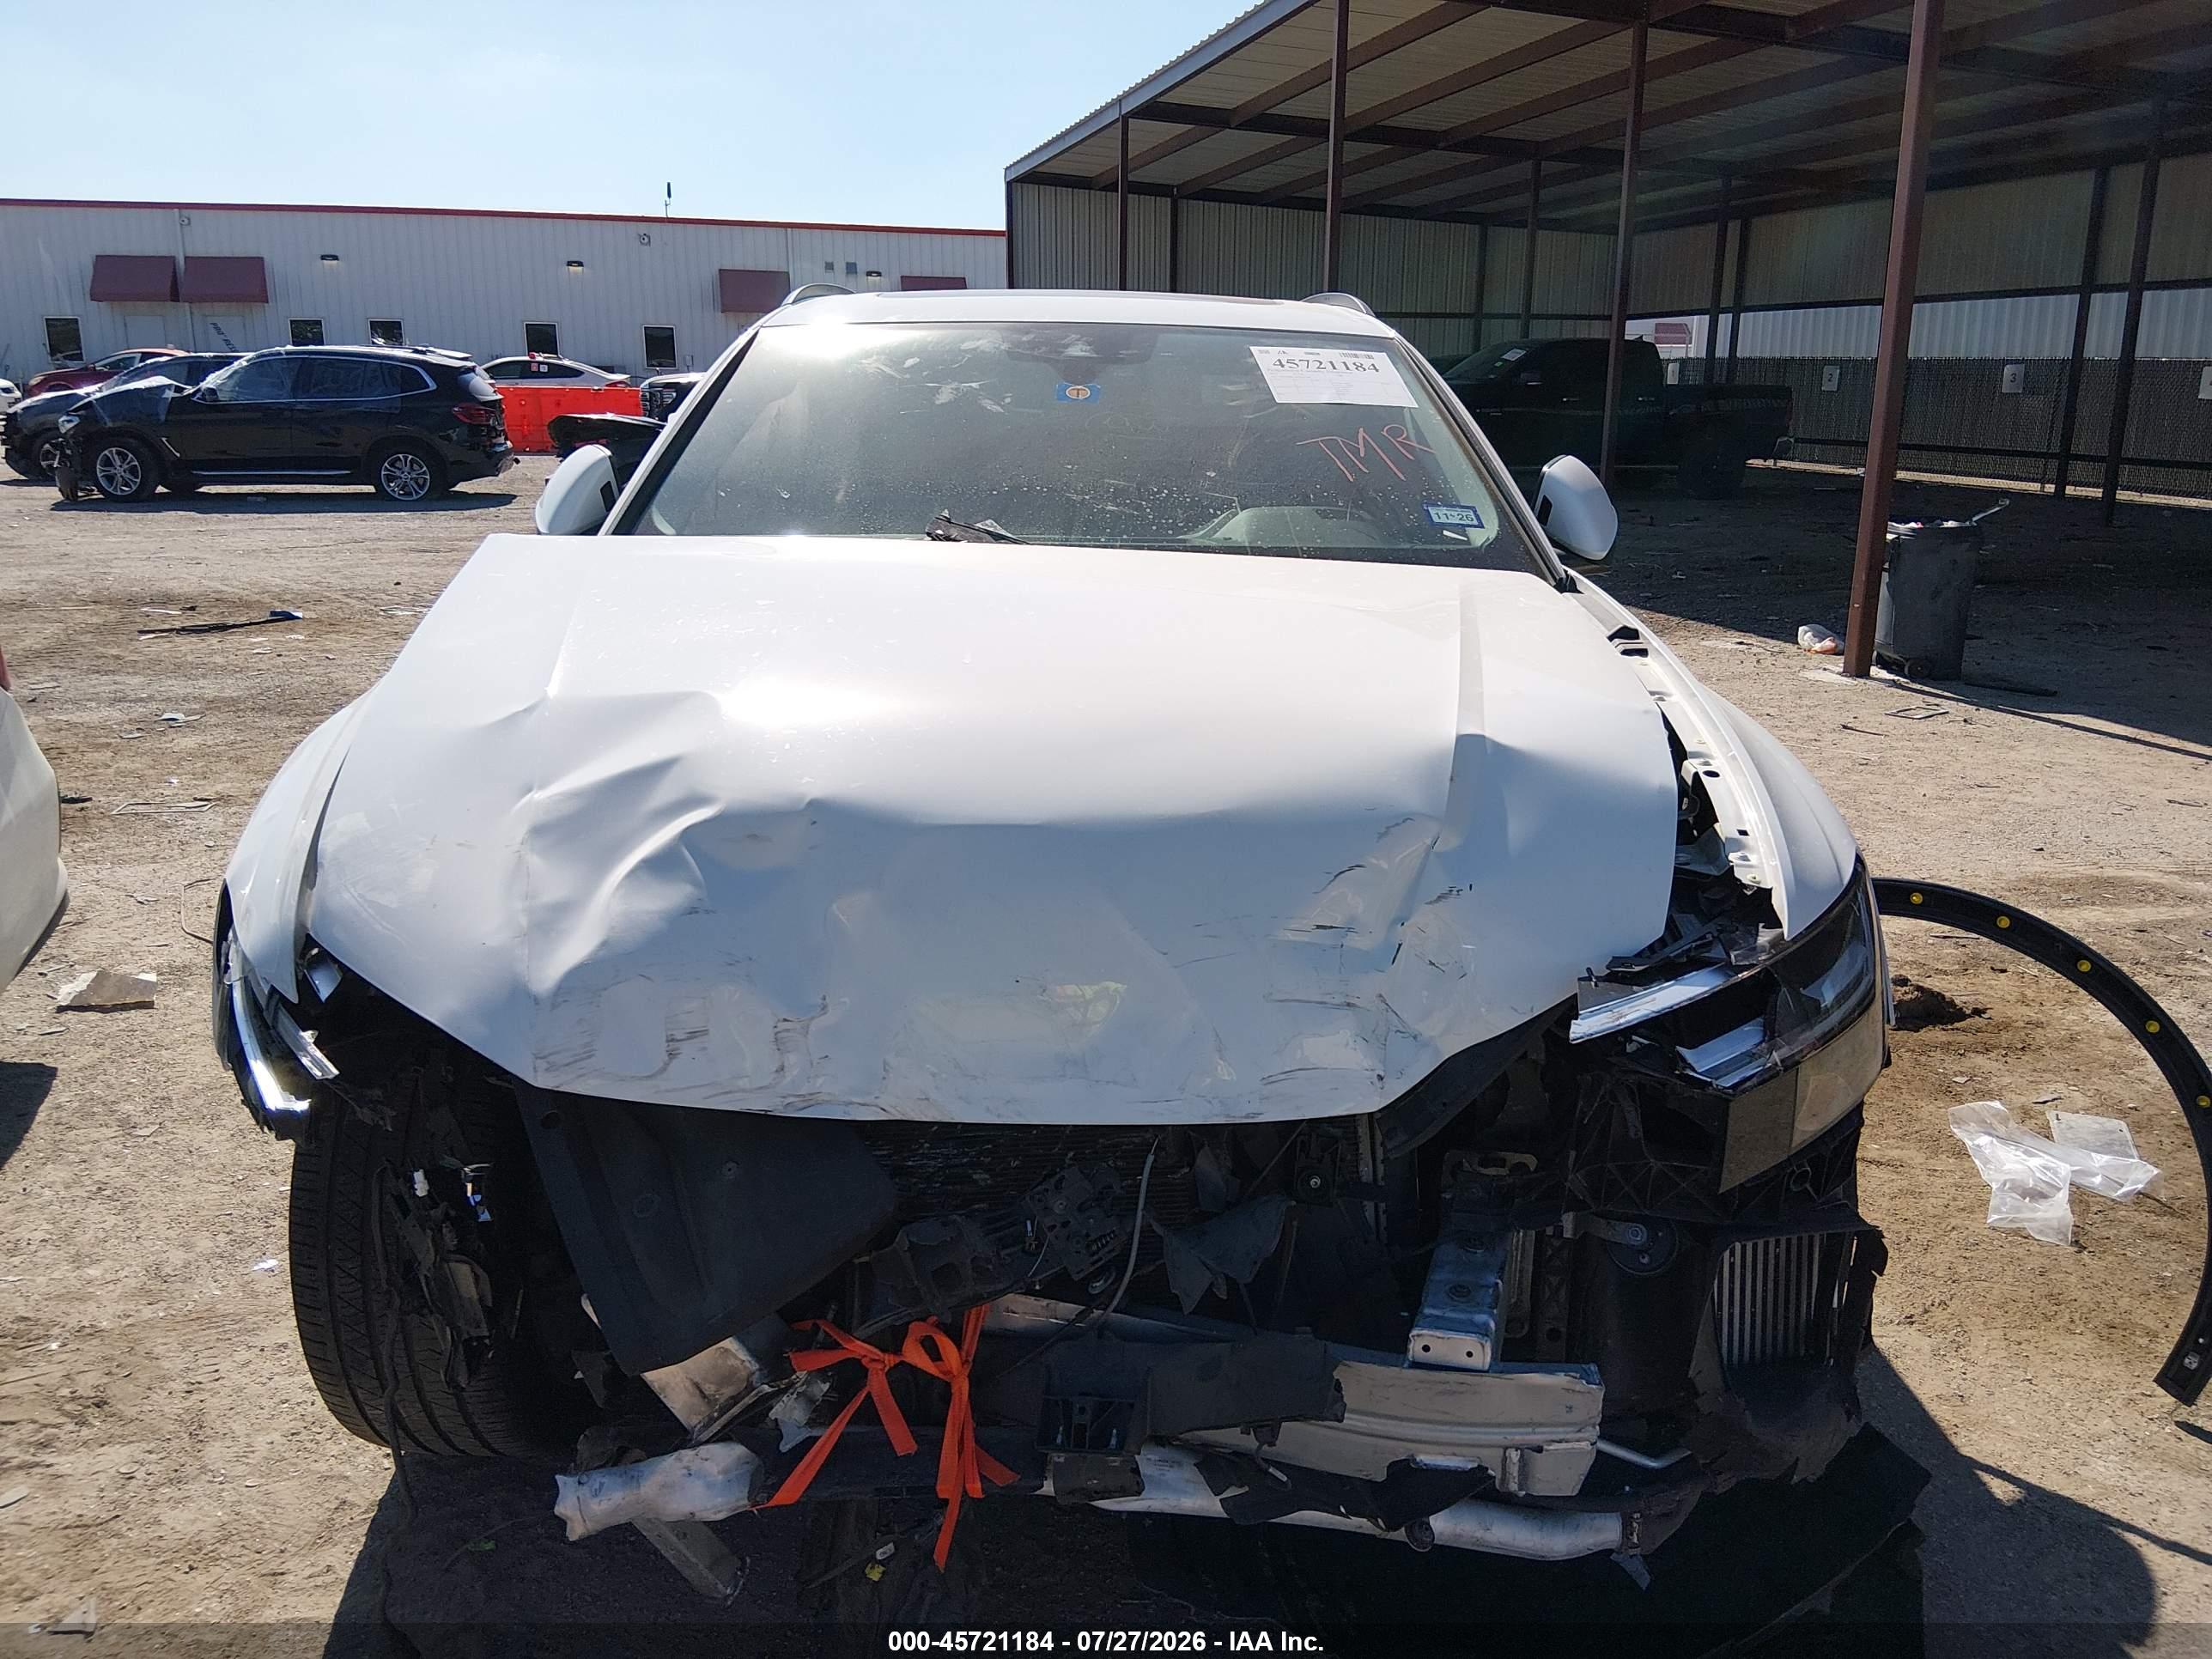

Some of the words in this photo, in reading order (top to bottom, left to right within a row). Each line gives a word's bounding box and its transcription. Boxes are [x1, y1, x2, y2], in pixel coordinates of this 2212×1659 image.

[1272, 358, 1380, 373] 45721184
[1827, 372, 1834, 383] 2
[2009, 372, 2018, 383] 3
[1296, 424, 1437, 483] TMR
